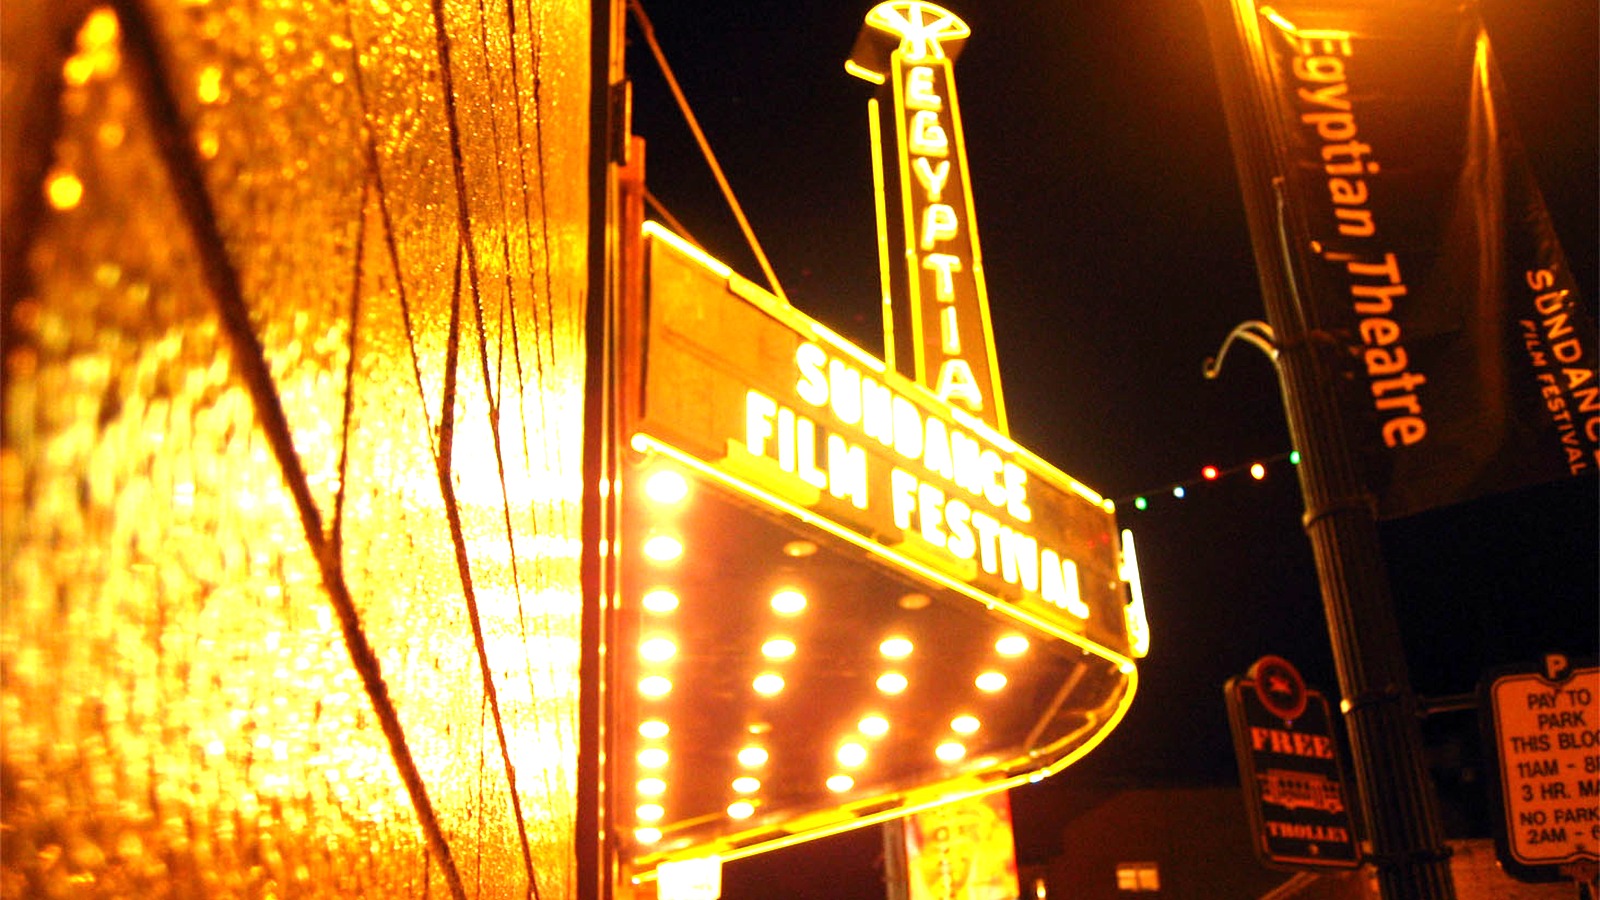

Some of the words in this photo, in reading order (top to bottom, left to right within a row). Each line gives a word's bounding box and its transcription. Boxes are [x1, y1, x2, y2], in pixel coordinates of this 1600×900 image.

[905, 65, 983, 412] EGYPTIA
[1293, 29, 1380, 237] Egyptian
[1347, 252, 1428, 449] Theatre
[1526, 269, 1600, 470] SUNDANC
[1519, 318, 1548, 367] FILM
[1537, 372, 1588, 476] FESTIVAL
[795, 341, 1032, 523] SUNDANCE
[745, 388, 869, 510] FILM
[890, 466, 1090, 620] FESTIVAL
[1545, 653, 1568, 679] P
[1527, 691, 1558, 710] PAY
[1567, 688, 1592, 707] TO
[1538, 710, 1587, 730] PARK
[1251, 725, 1335, 760] FREE
[1510, 734, 1551, 753] THIS
[1517, 758, 1559, 779] 11AM
[1522, 784, 1534, 803] 3
[1541, 781, 1571, 801] HR.
[1520, 810, 1547, 827] NO
[1266, 820, 1349, 843] TROLLEY
[1527, 827, 1567, 846] 2AM
